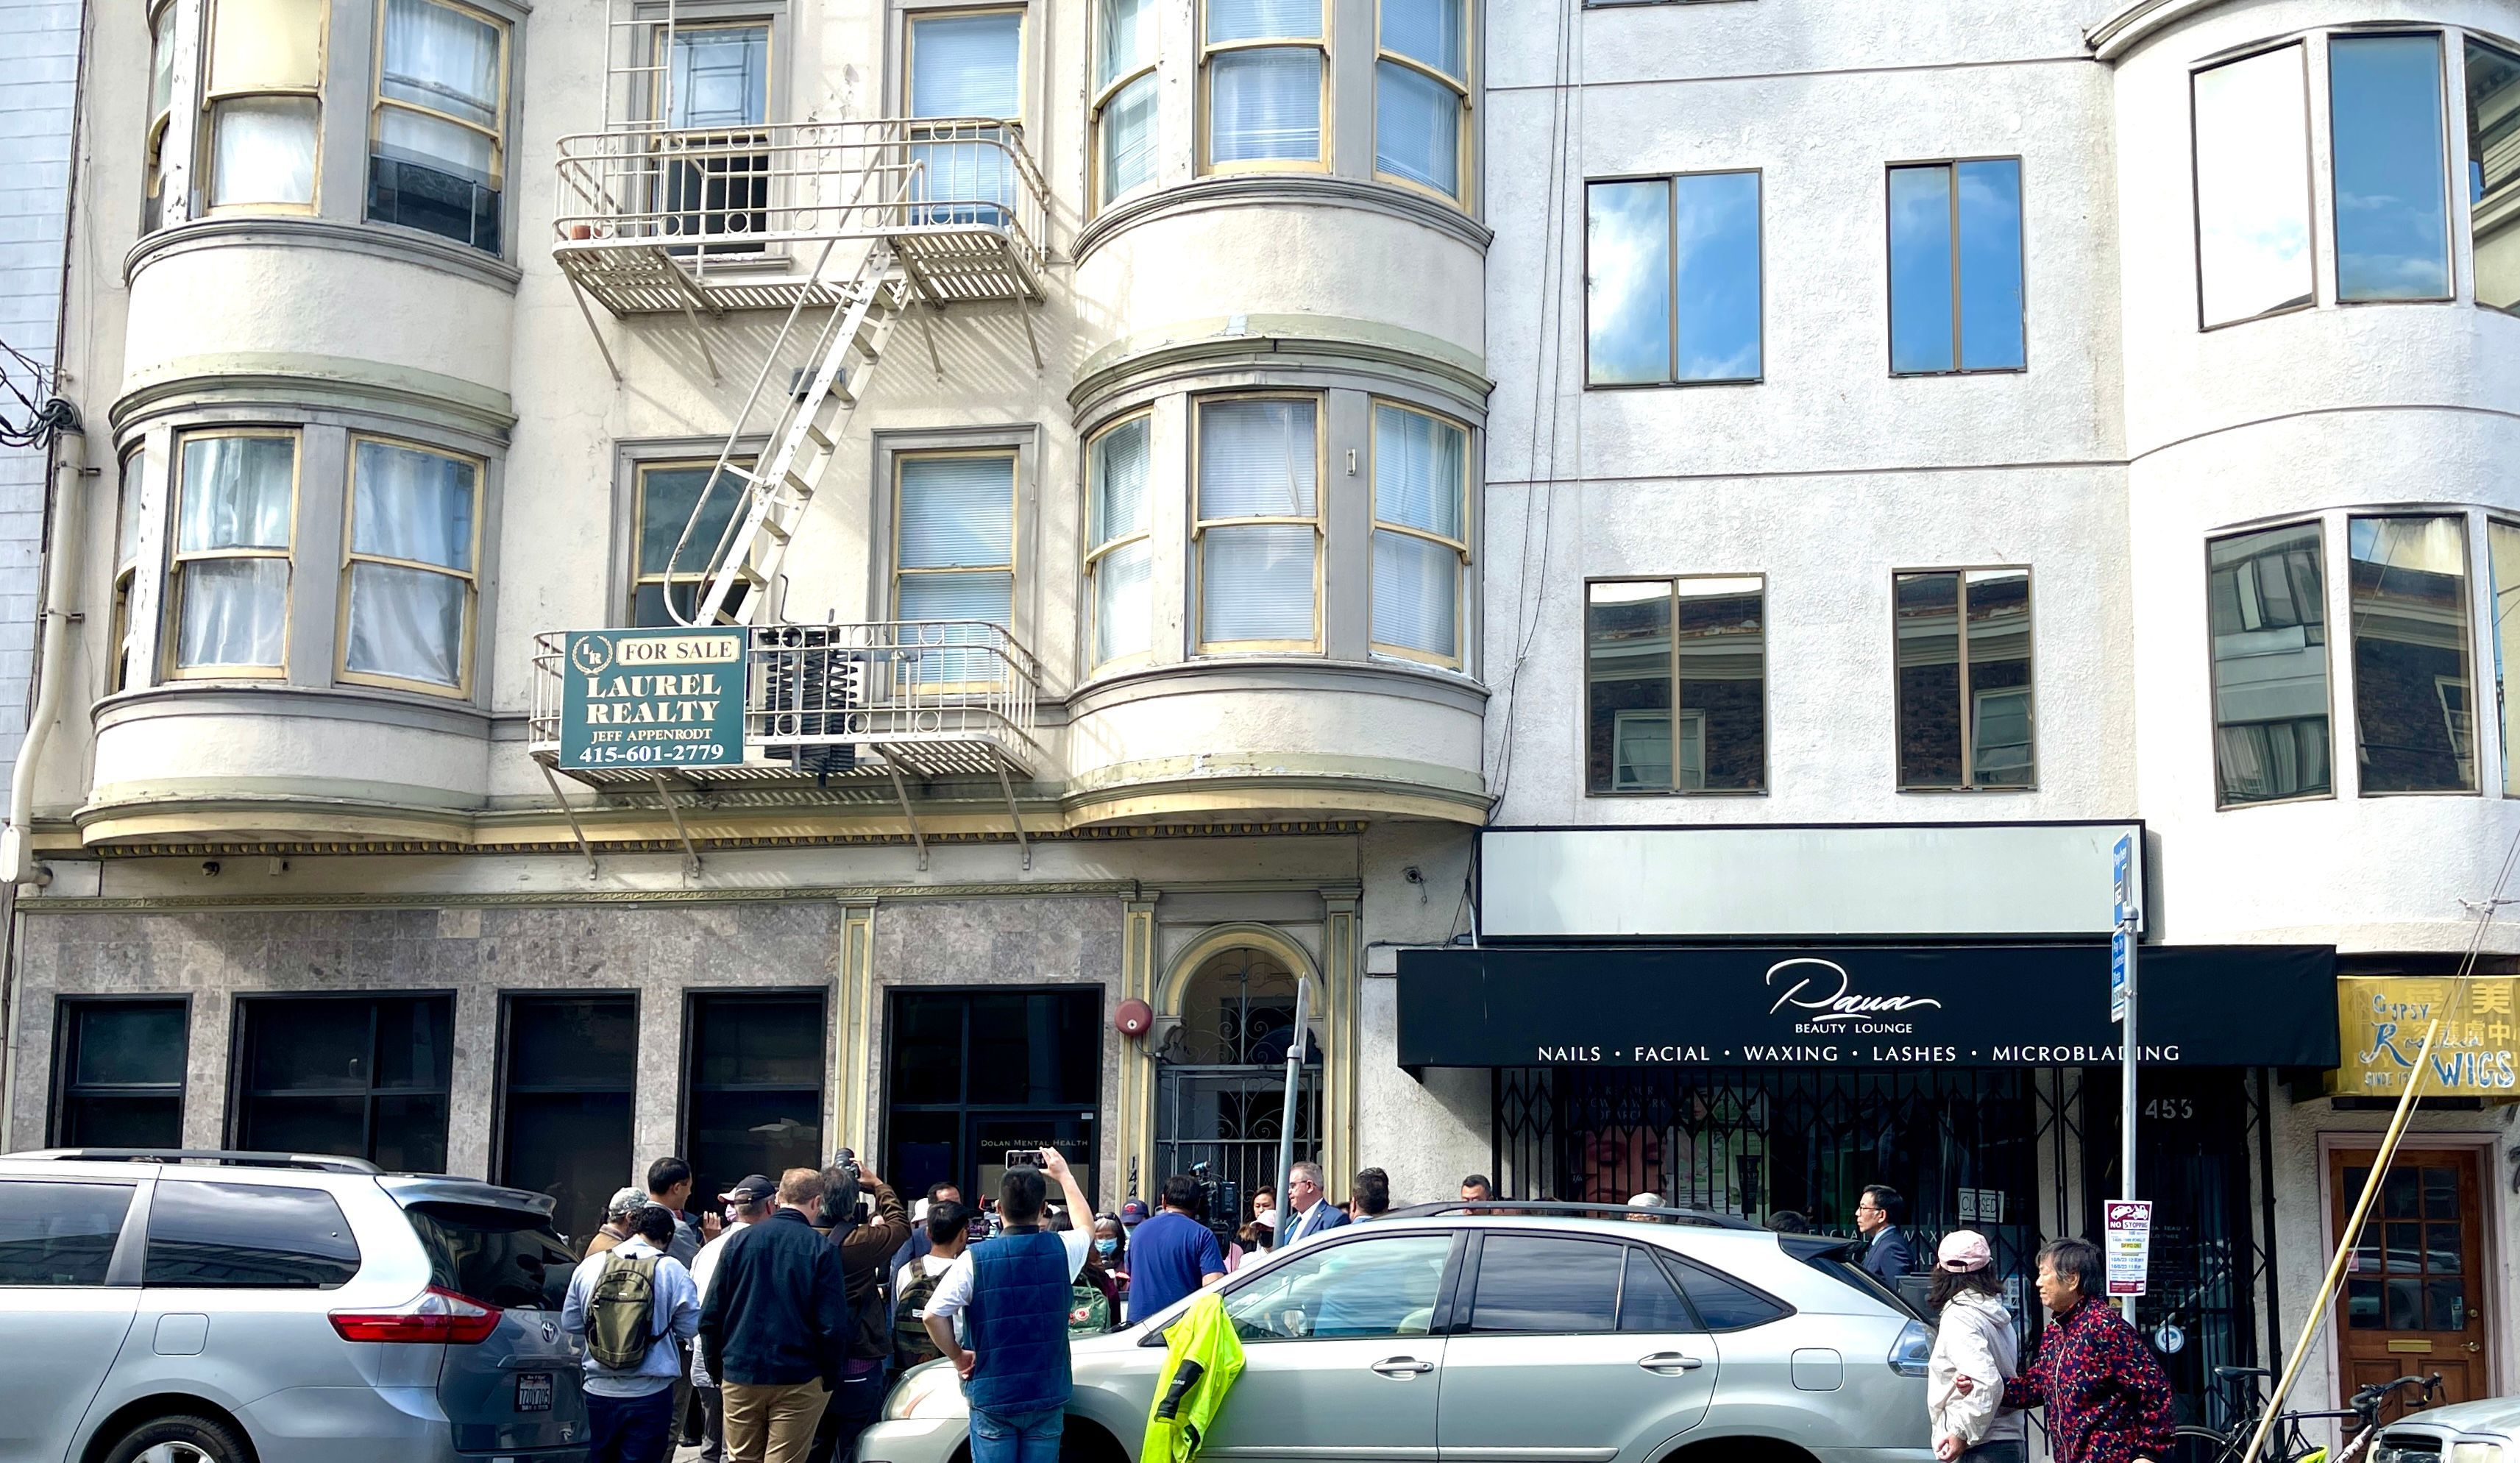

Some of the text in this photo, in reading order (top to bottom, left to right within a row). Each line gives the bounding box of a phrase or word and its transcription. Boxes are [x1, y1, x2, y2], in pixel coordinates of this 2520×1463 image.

[625, 641, 732, 660] FOR SALE
[586, 673, 722, 698] LAUREL
[586, 701, 720, 724] REALTY
[591, 728, 713, 744] JEFF APPENRODT
[579, 744, 724, 763] 415-601-2779
[1795, 1023, 1913, 1033] BEAUTY LOUNGE
[1538, 1046, 1601, 1061] NAILS
[1635, 1046, 1710, 1061] FACIAL
[1743, 1046, 1838, 1061] WAXING
[1873, 1046, 1956, 1061] LASHES
[2365, 1071, 2393, 1086] SINCE
[2430, 1050, 2516, 1088] WIGS
